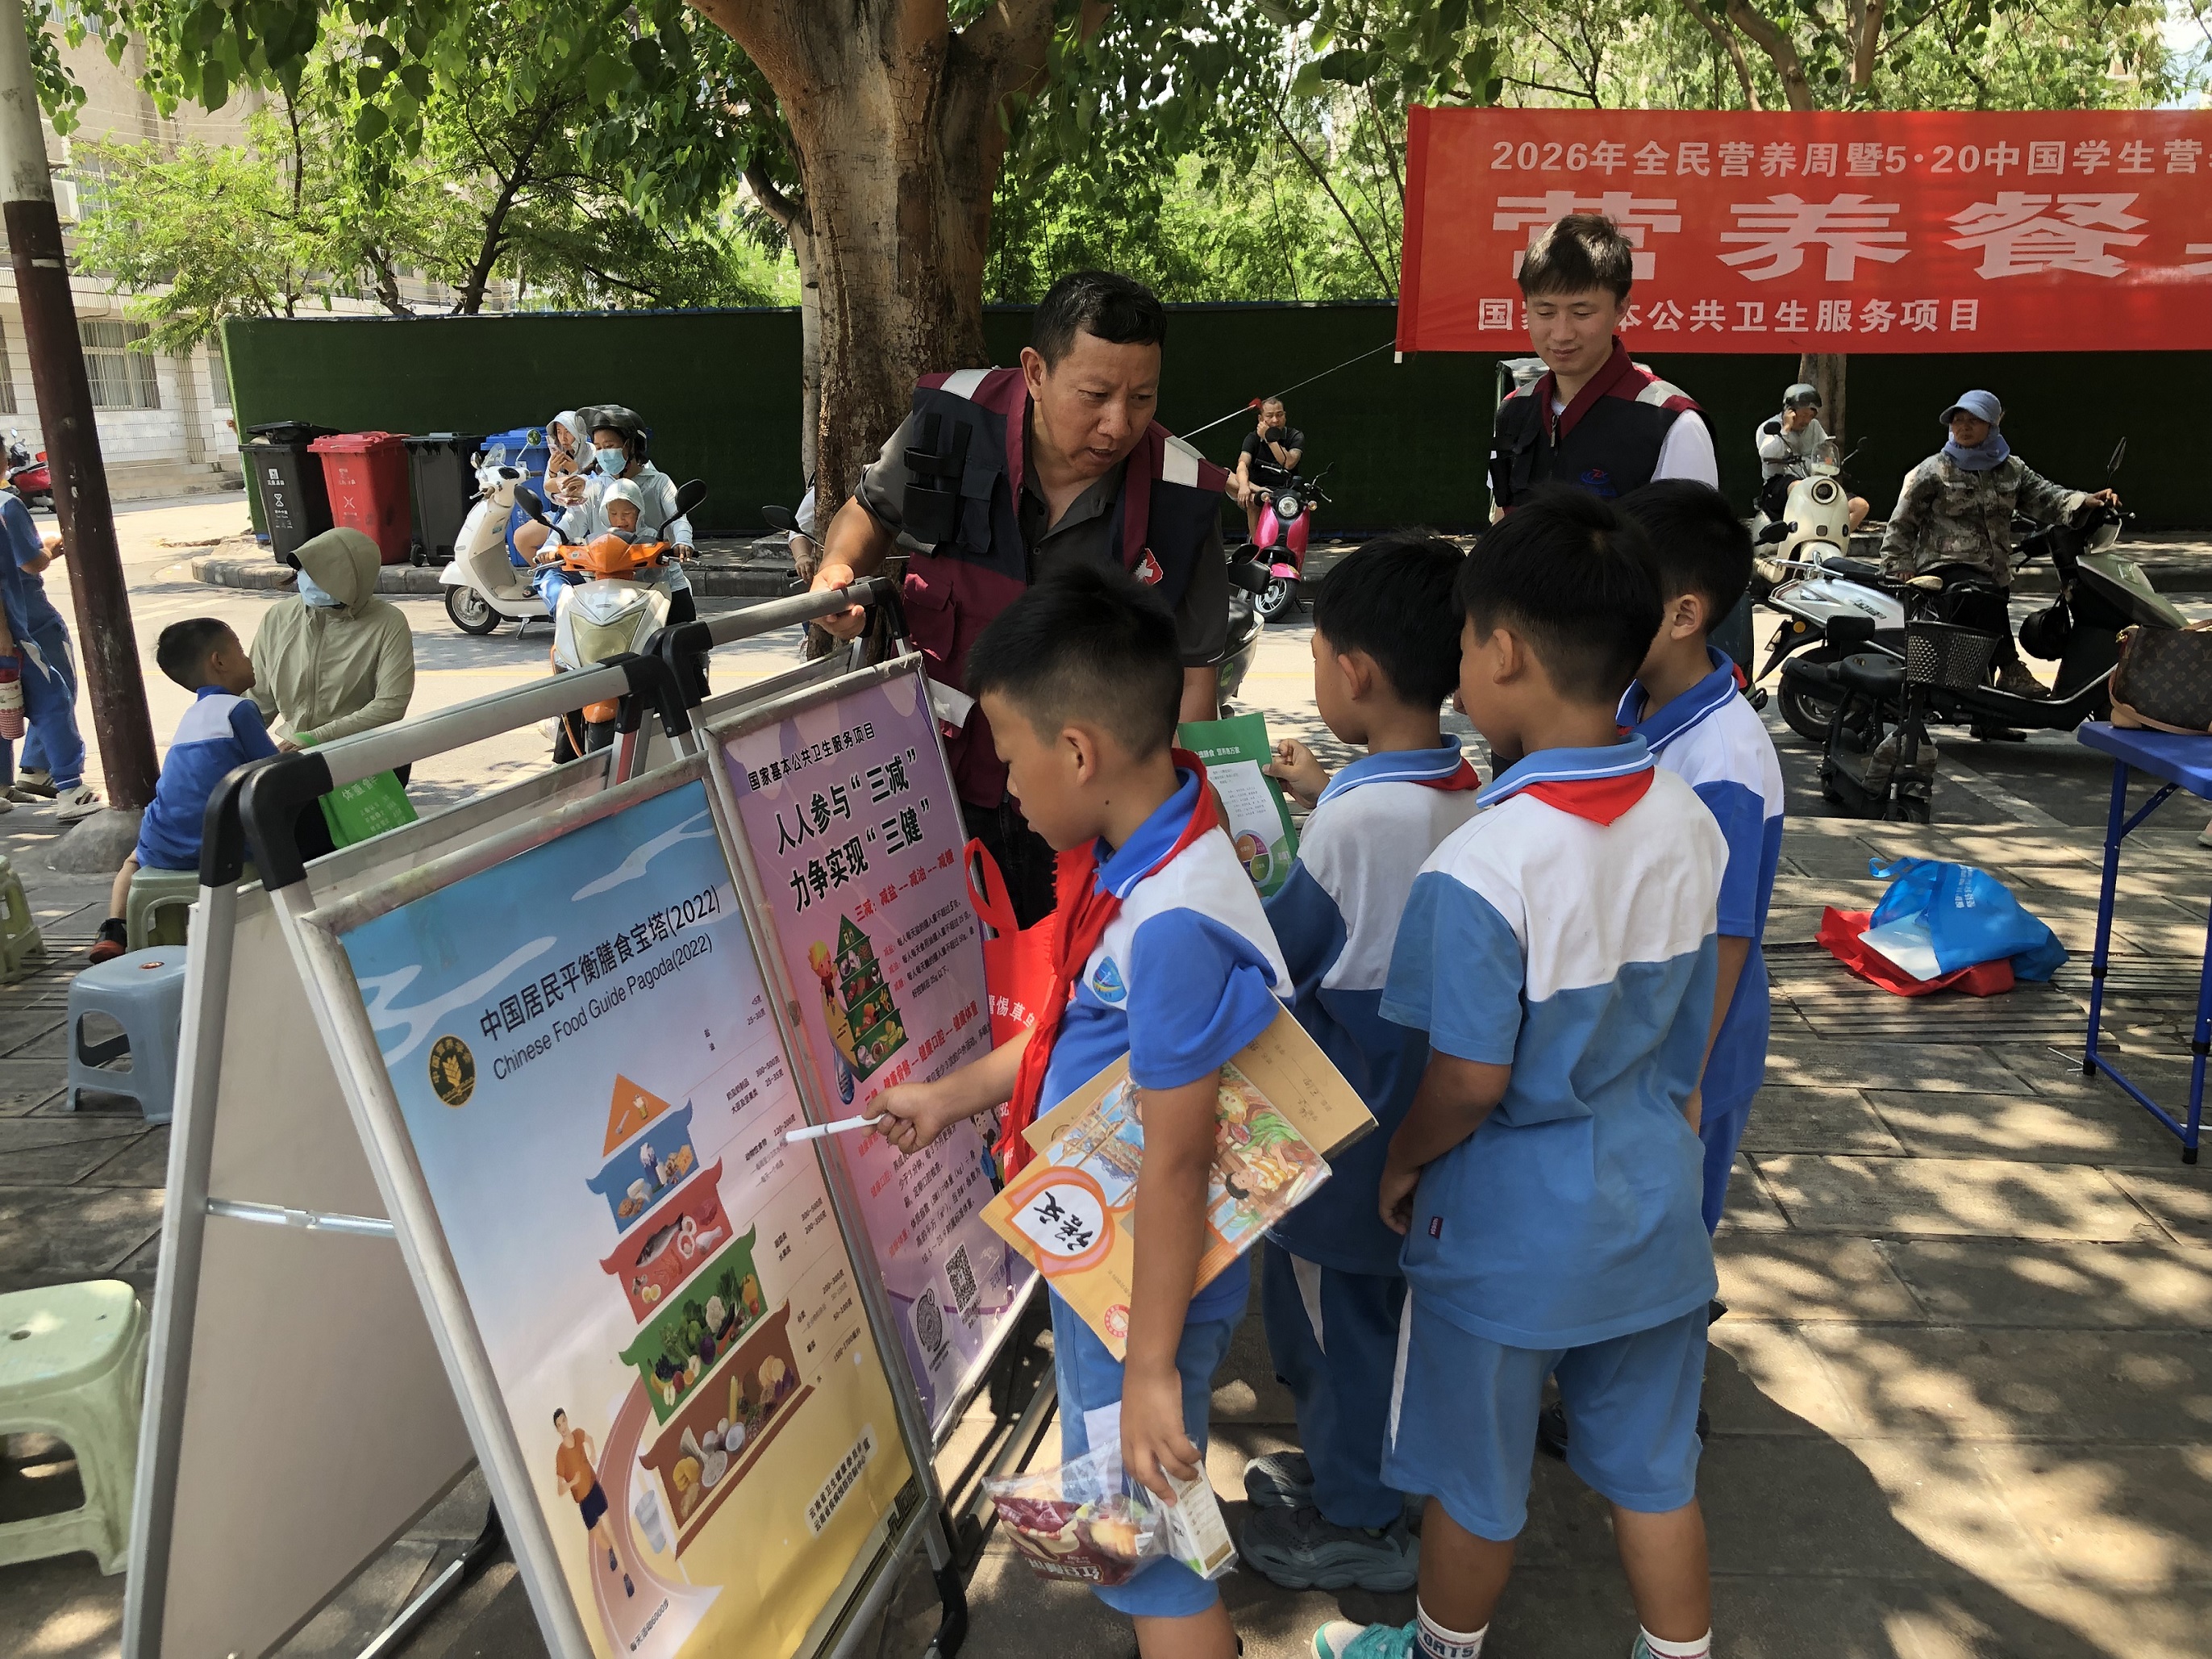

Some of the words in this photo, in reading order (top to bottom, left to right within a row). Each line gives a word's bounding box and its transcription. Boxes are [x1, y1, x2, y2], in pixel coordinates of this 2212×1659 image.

[1490, 139, 2212, 178] 2026年全民营养周暨5·20中国学生营
[1493, 190, 2212, 281] 营养餐
[1478, 298, 1979, 333] 国本公共卫生服务项目
[748, 722, 875, 791] 国家基本公共卫生服务项目
[479, 885, 722, 1042] 中国居民平衡膳食宝塔(2022)
[494, 1033, 552, 1081] Chinese
[553, 1012, 587, 1045] Food
[589, 986, 627, 1021] Guide
[627, 932, 713, 995] Pagoda(2022)
[1033, 1191, 1093, 1251] 语文
